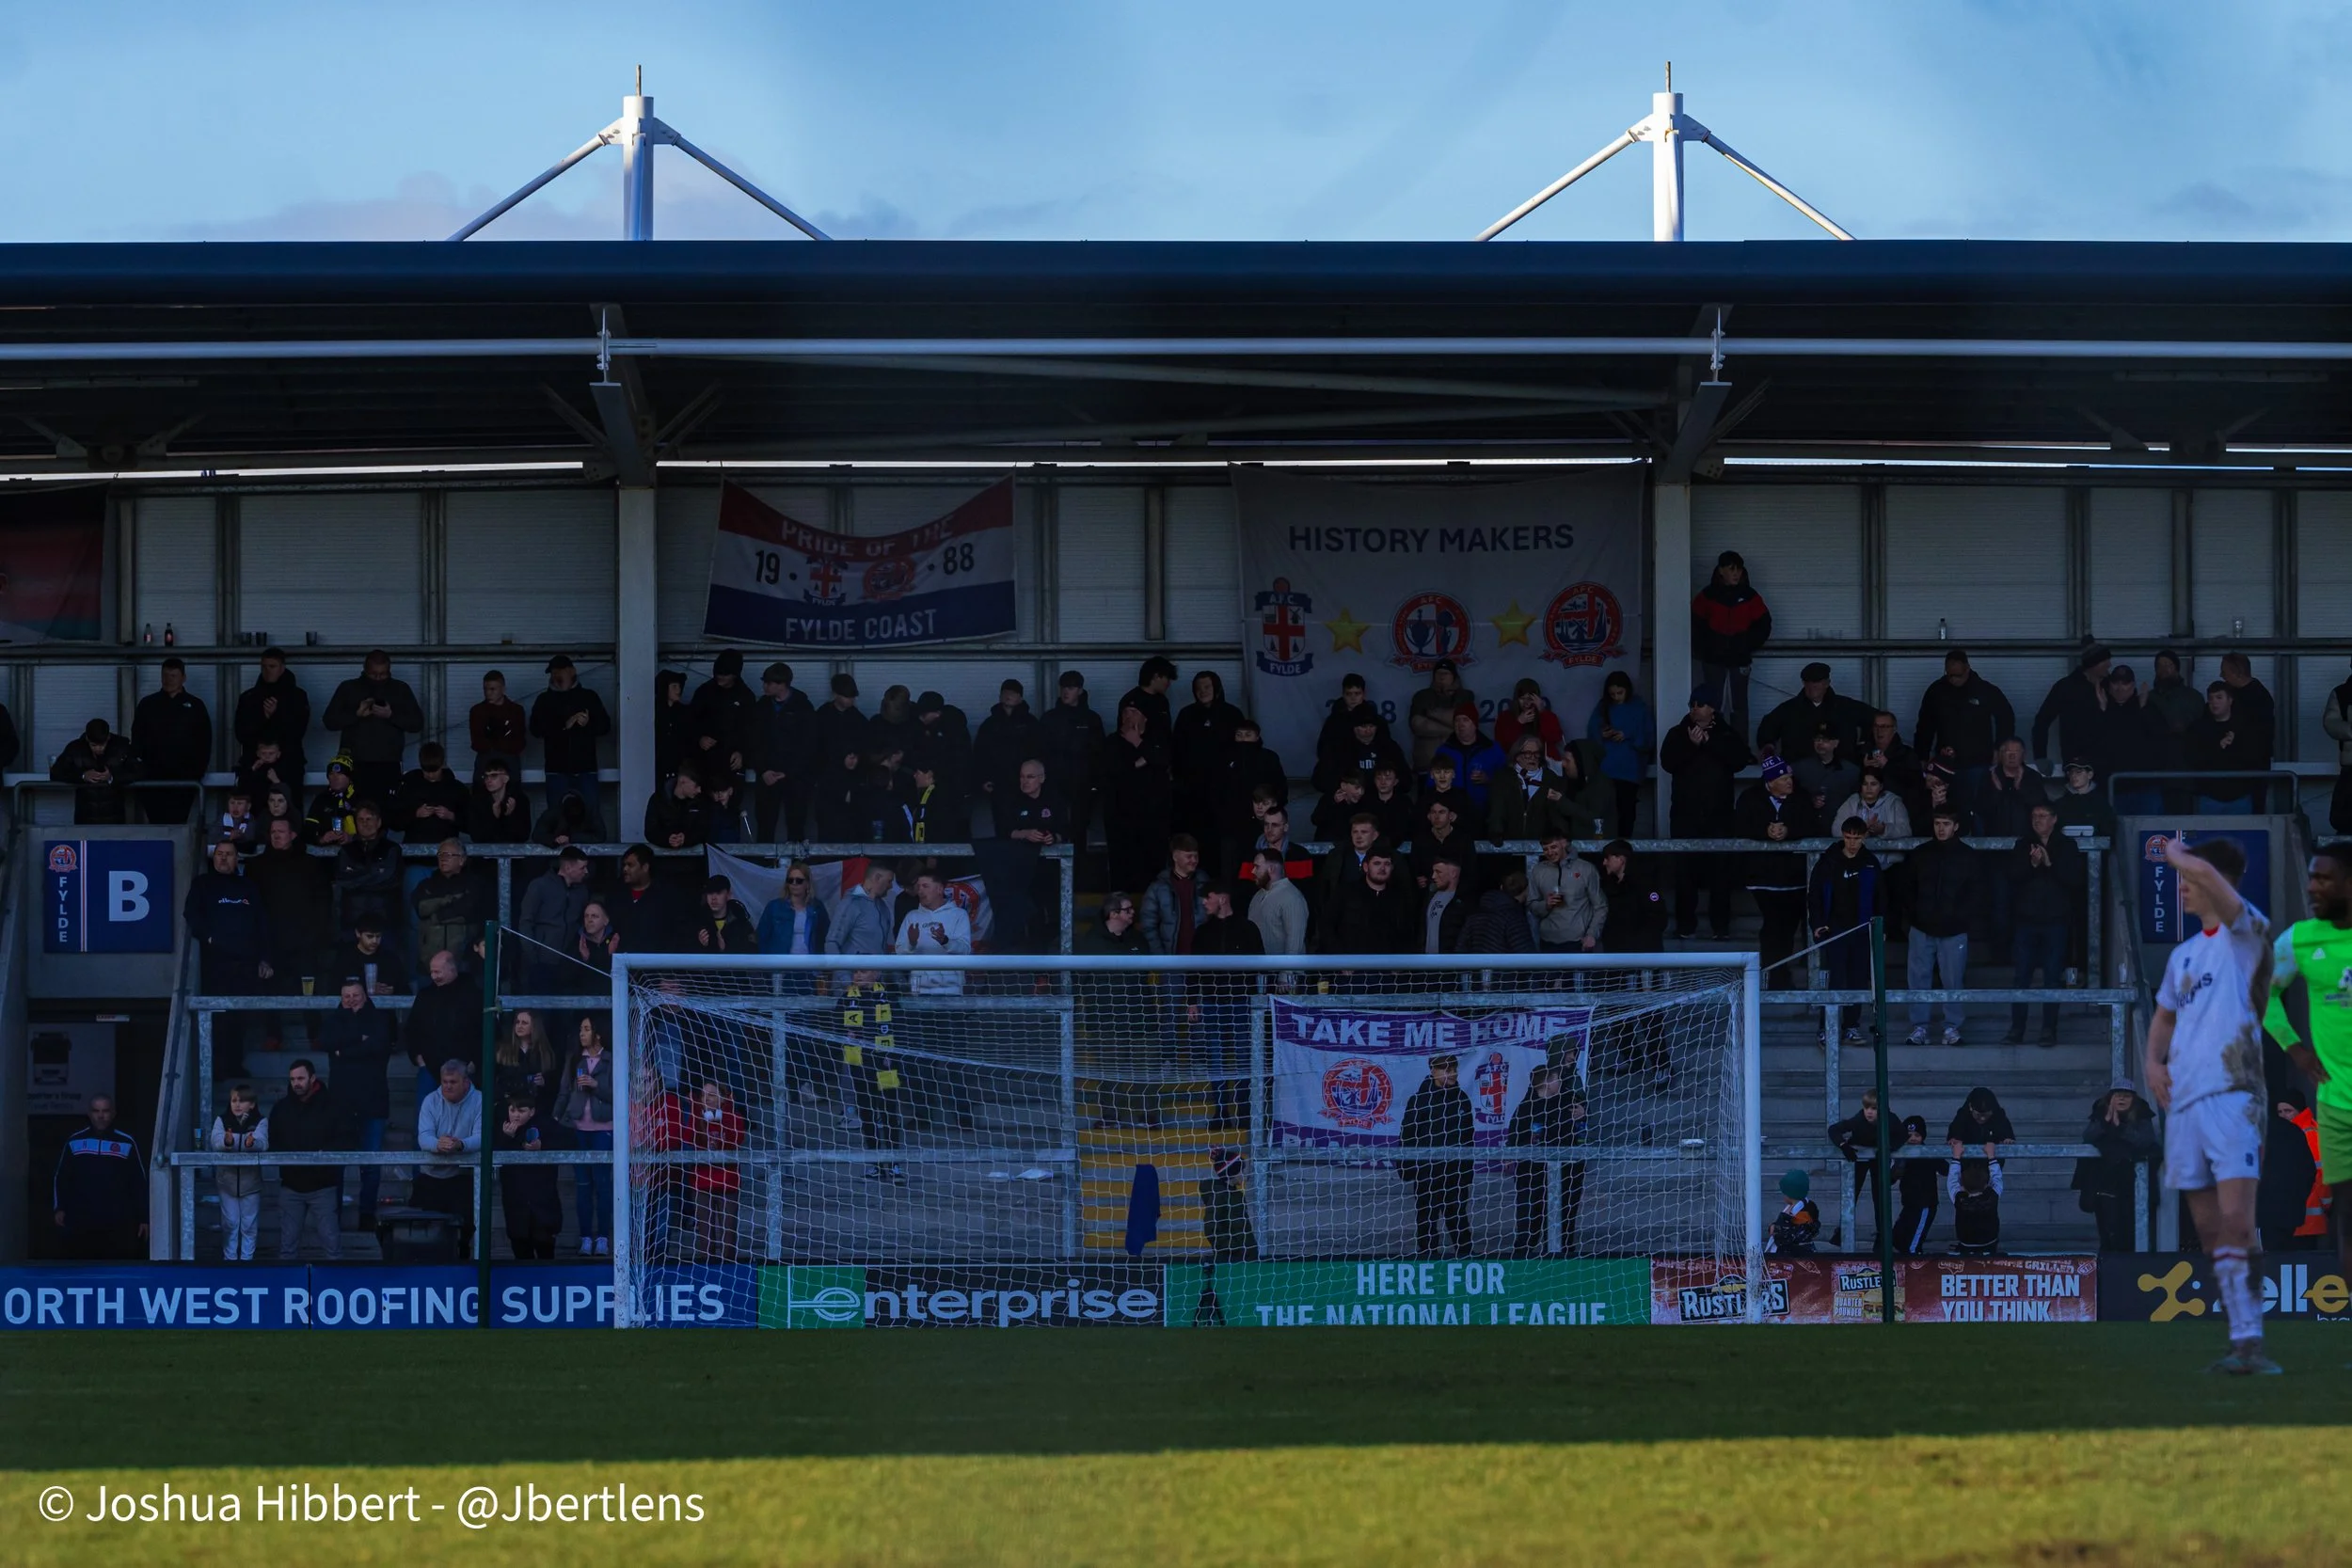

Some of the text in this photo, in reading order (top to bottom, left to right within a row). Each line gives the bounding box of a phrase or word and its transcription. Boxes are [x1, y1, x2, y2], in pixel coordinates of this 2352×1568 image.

[782, 515, 954, 558] PRIDE OF THE
[1289, 523, 1574, 553] HISTORY MAKERS
[755, 542, 975, 585] 19 88
[785, 608, 937, 641] FYLDE COAST
[1269, 662, 1302, 675] FYLDE
[57, 876, 70, 942] FYLDE
[108, 870, 151, 922] B
[2153, 865, 2165, 933] FYLDE
[1290, 1013, 1567, 1048] TAKE ME HOME
[1358, 1261, 1505, 1296] HERE FOR
[1941, 1274, 2081, 1298] BETTER THAN
[139, 1287, 269, 1324] WEST
[284, 1287, 479, 1325] ROOFING
[813, 1278, 1158, 1329] enterprise
[1256, 1302, 1607, 1326] THE NATIONAL LEAGUE
[1941, 1301, 2052, 1322] YOU THINK
